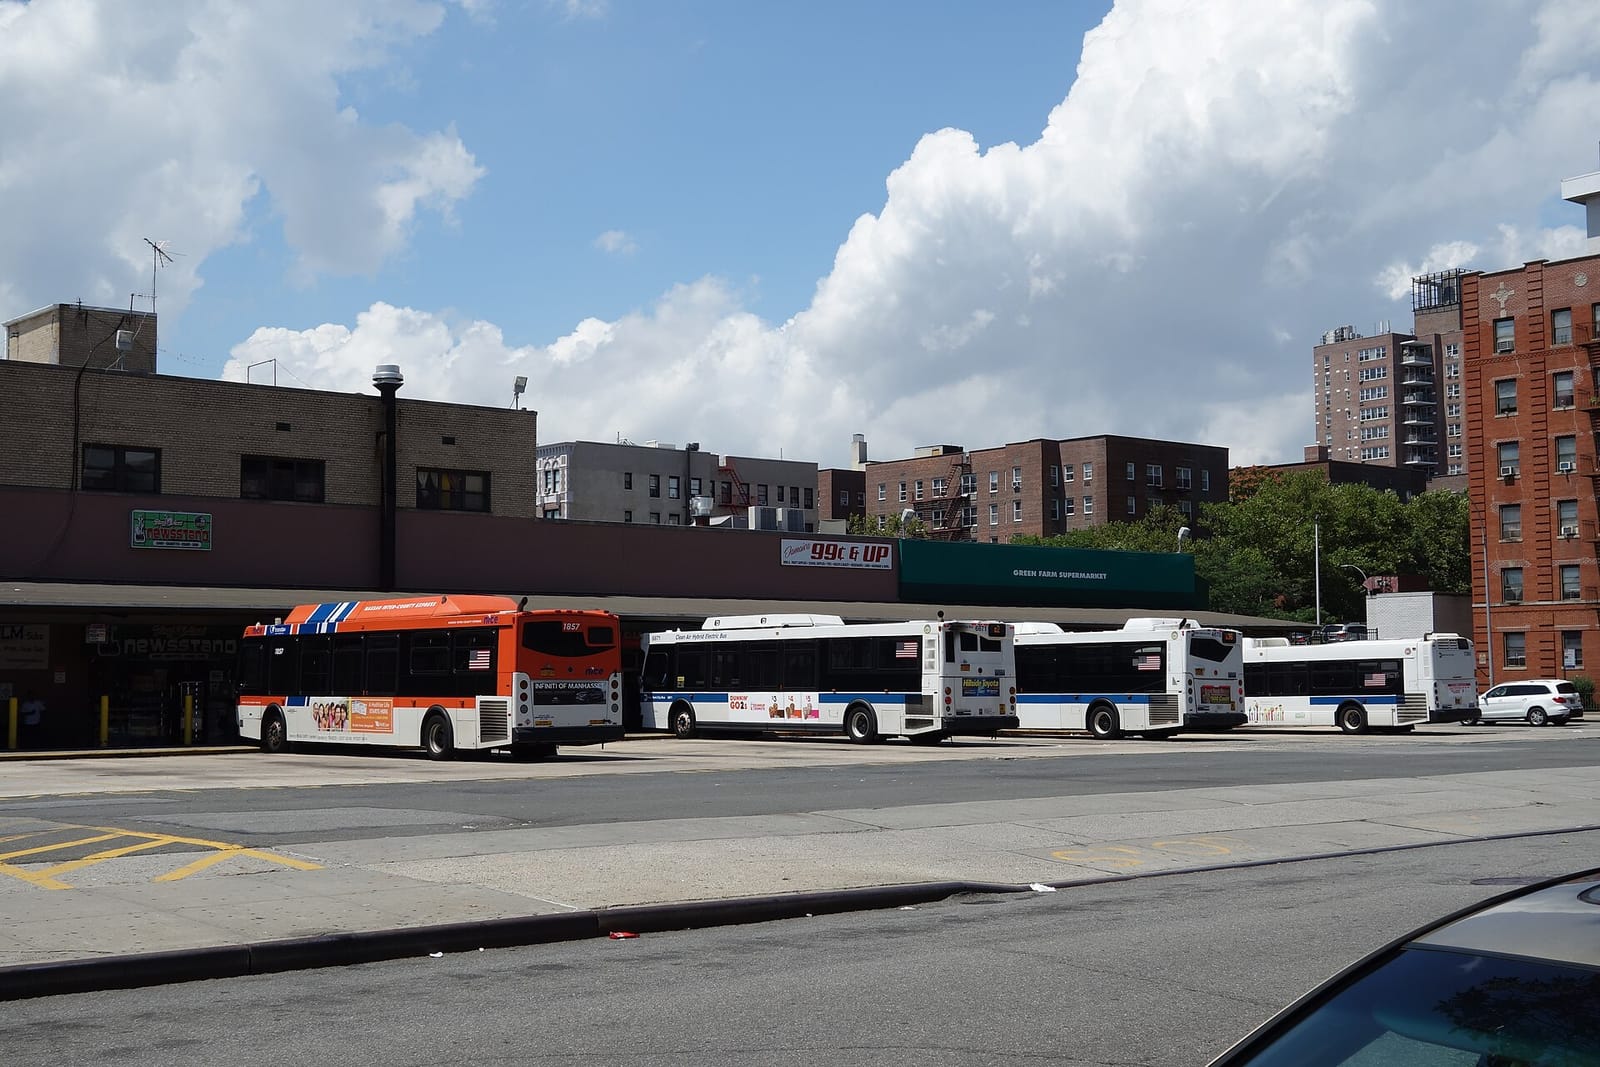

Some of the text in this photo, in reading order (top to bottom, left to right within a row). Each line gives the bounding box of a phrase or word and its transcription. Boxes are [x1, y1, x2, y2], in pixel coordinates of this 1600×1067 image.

[811, 543, 889, 563] 99¢ & UP
[1013, 569, 1108, 580] GREEN FARM SUPERMARKET
[563, 623, 580, 631] 1857
[692, 633, 705, 641] Hybrid
[705, 632, 719, 640] Electric
[963, 679, 999, 688] Hillside Toyota
